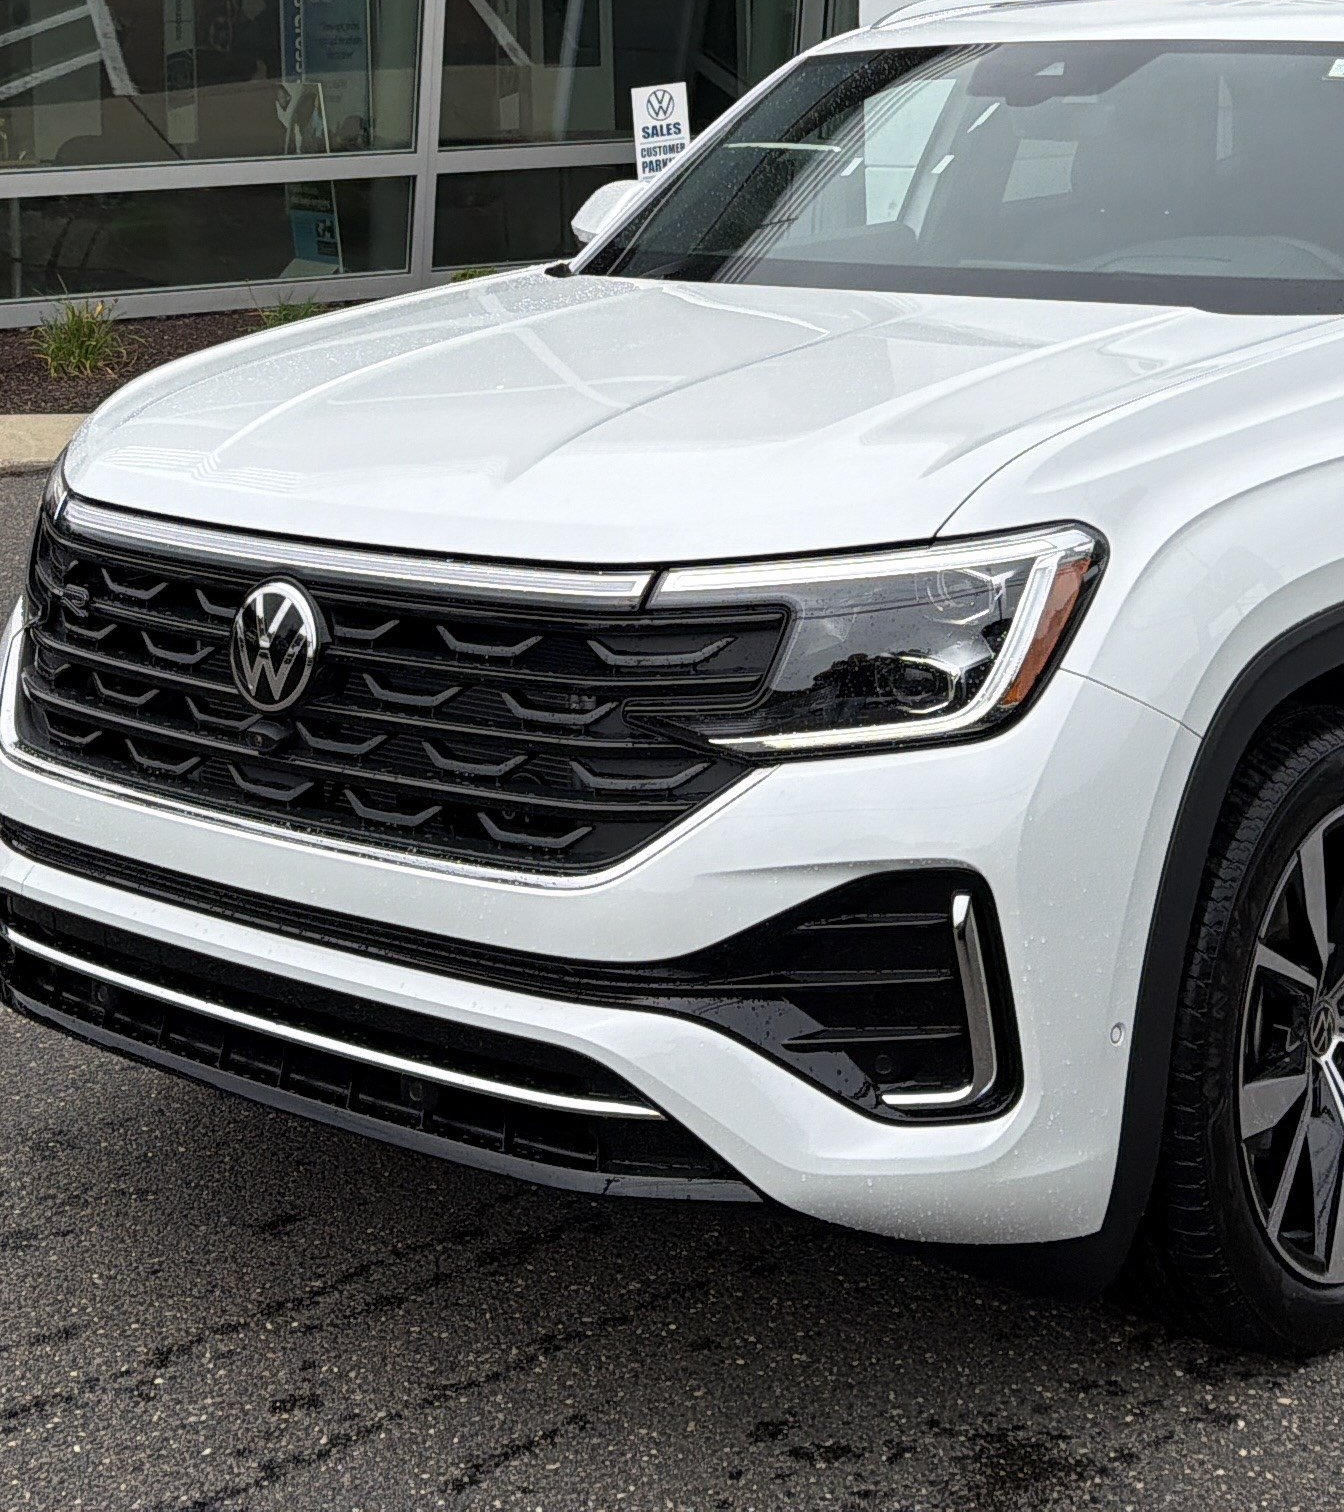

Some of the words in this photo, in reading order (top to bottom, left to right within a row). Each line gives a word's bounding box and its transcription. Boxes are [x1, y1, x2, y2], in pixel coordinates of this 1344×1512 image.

[641, 122, 682, 140] SALES
[640, 143, 686, 159] CUSTOMER
[642, 157, 676, 175] PARK
